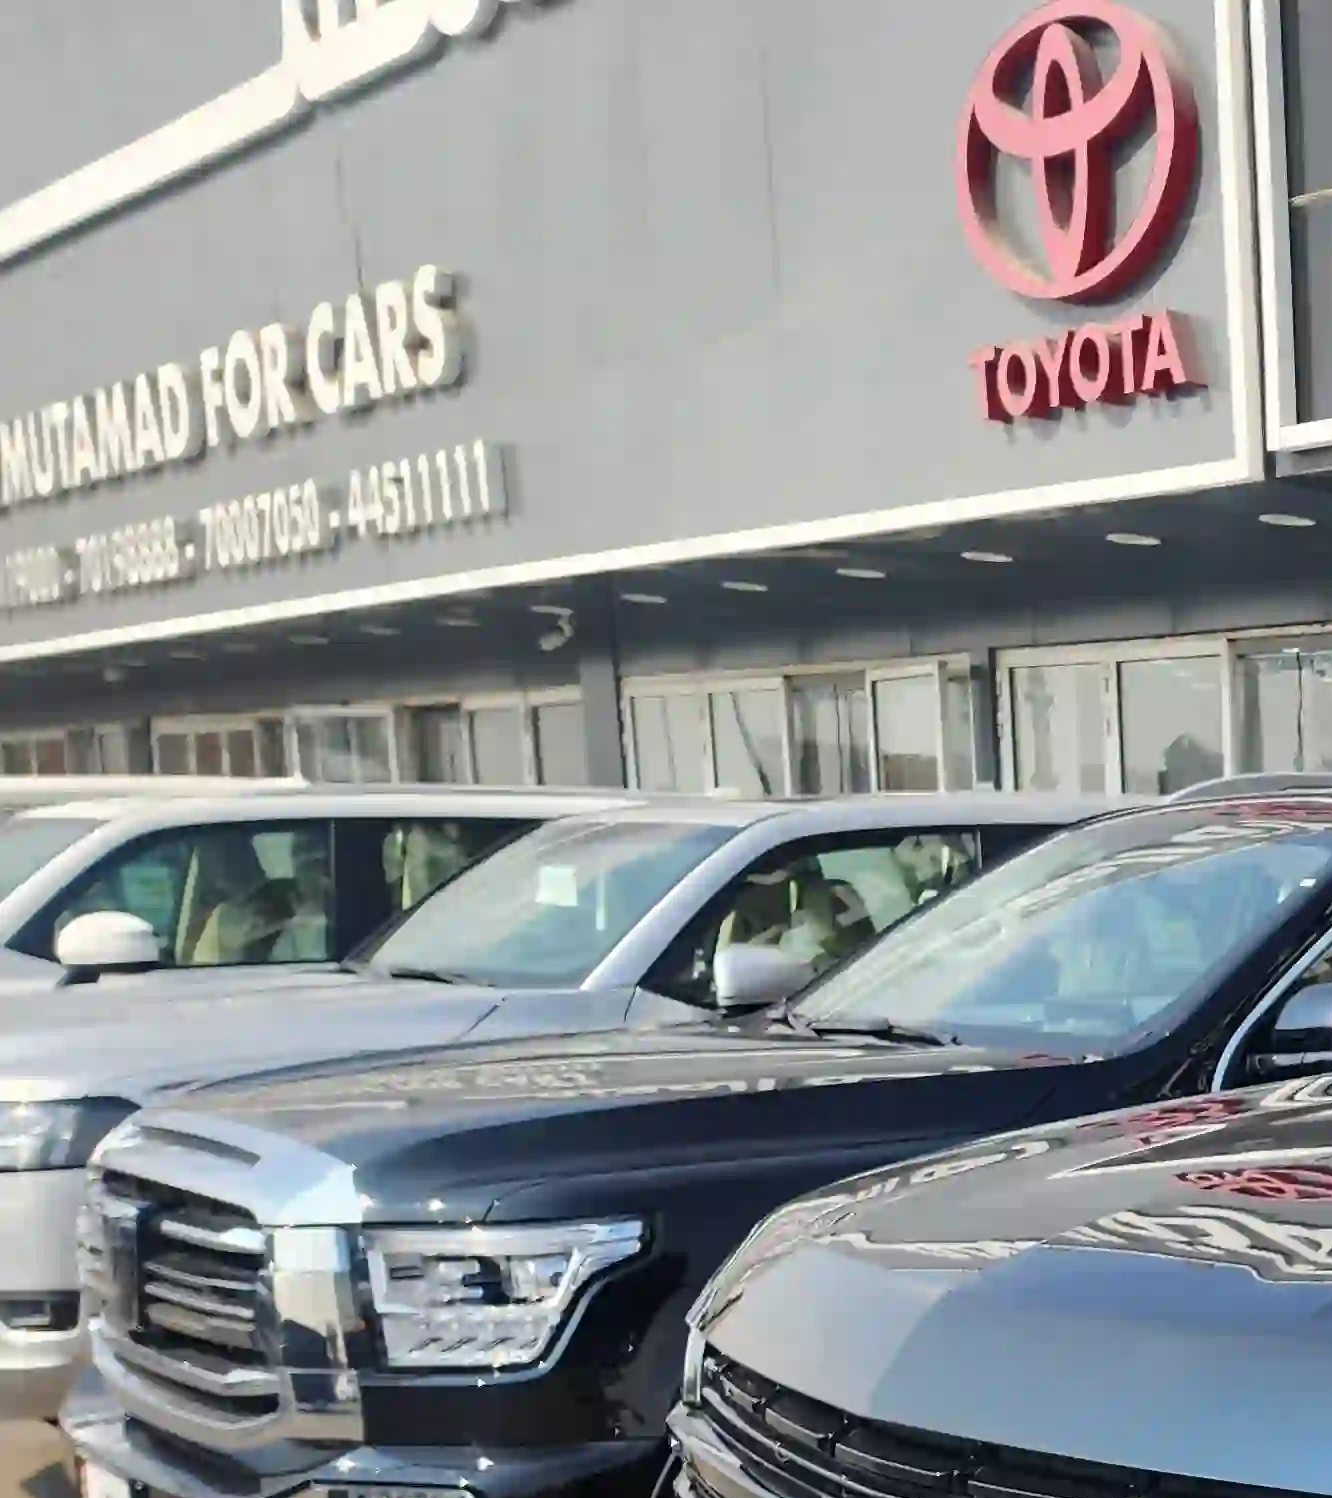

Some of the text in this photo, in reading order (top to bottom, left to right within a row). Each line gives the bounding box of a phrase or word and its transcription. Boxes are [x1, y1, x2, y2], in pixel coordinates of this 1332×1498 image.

[0, 263, 462, 500] MUTAMAD FOR CARS
[968, 308, 1195, 423] TOYOTA
[348, 438, 490, 536] 44511111
